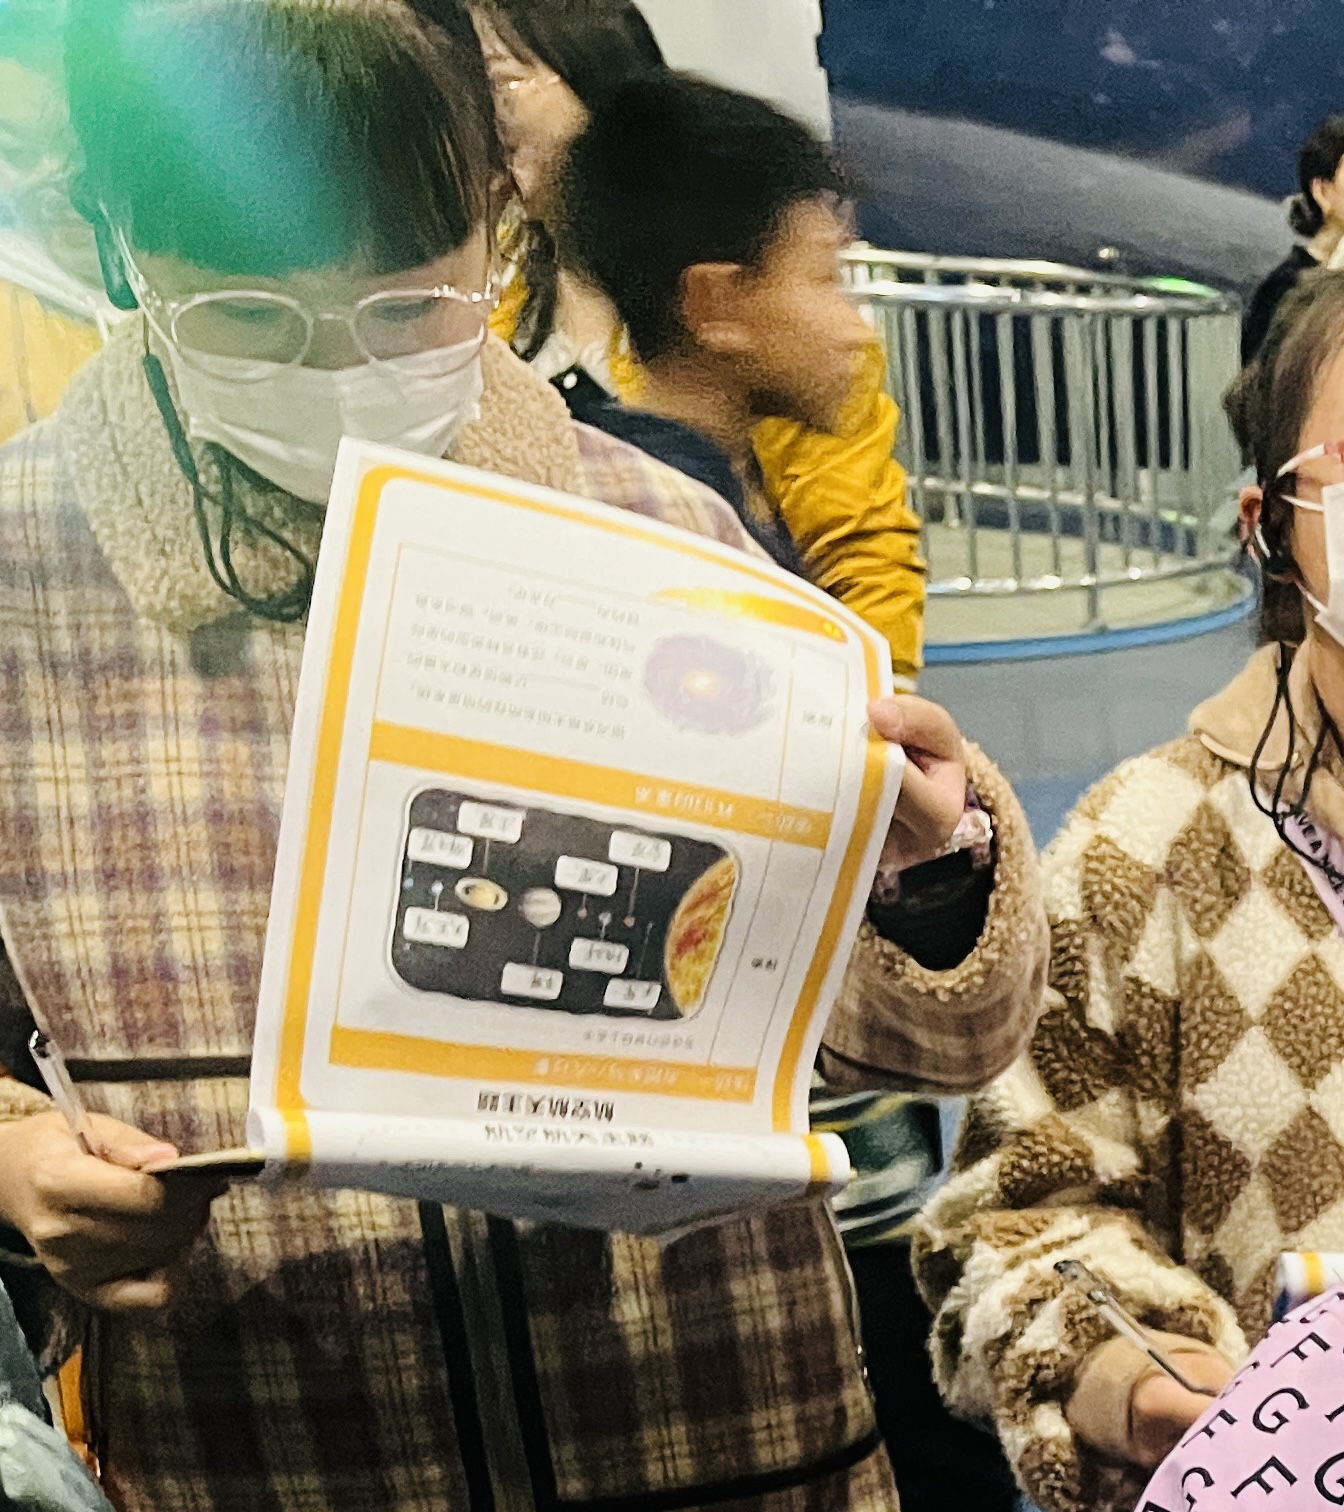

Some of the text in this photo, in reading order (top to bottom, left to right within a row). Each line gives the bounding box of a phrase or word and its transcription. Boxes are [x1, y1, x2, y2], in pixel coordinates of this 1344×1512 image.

[476, 1090, 616, 1122] 航空航天主题
[1252, 1388, 1309, 1434] G
[1231, 1456, 1297, 1498] F
